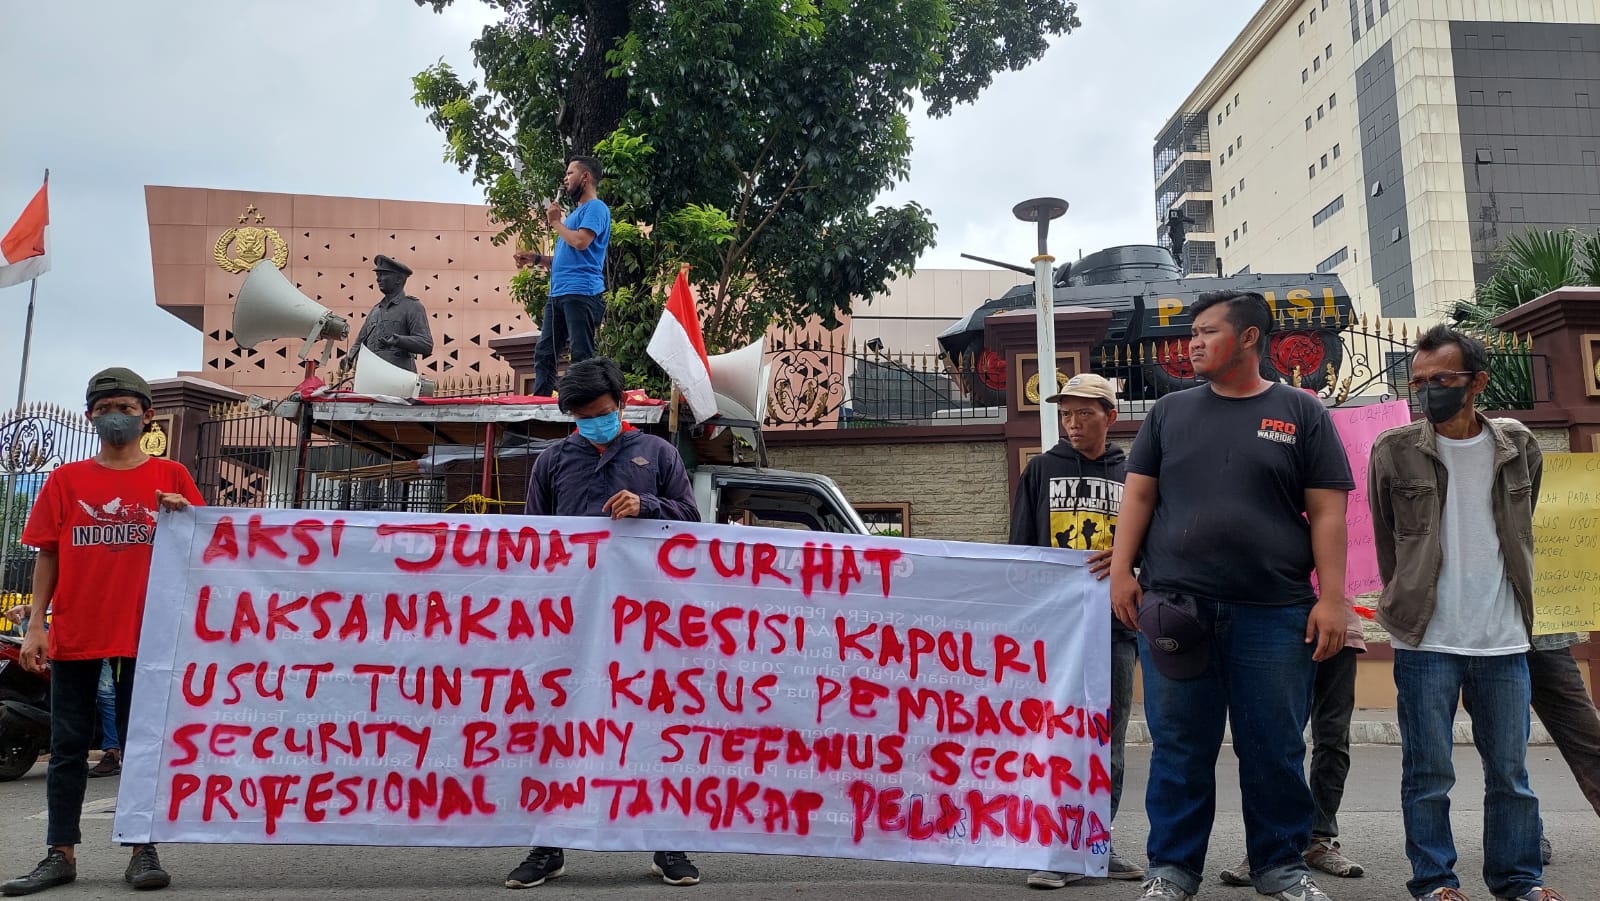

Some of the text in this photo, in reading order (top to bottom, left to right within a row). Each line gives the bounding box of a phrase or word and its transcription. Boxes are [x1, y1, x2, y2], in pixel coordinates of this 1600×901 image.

[1158, 287, 1336, 326] PISI
[1257, 430, 1297, 445] WARRIORS
[1261, 418, 1296, 435] PRO
[1050, 480, 1080, 498] MY
[203, 515, 346, 566] AKSI
[377, 521, 611, 574] JUMAT
[657, 532, 903, 598] CURHAT
[194, 585, 1047, 684] LAKSANAKAN PRESISI KAPOLRI
[182, 661, 334, 708] USUT
[353, 664, 572, 715] TUNTAS
[609, 660, 777, 716] KASUS
[169, 721, 432, 770] SECURITY
[462, 718, 634, 768] BENNY
[660, 724, 908, 775] STEFANUS
[928, 741, 1111, 799] SECARA
[590, 774, 823, 837] TANGKAT
